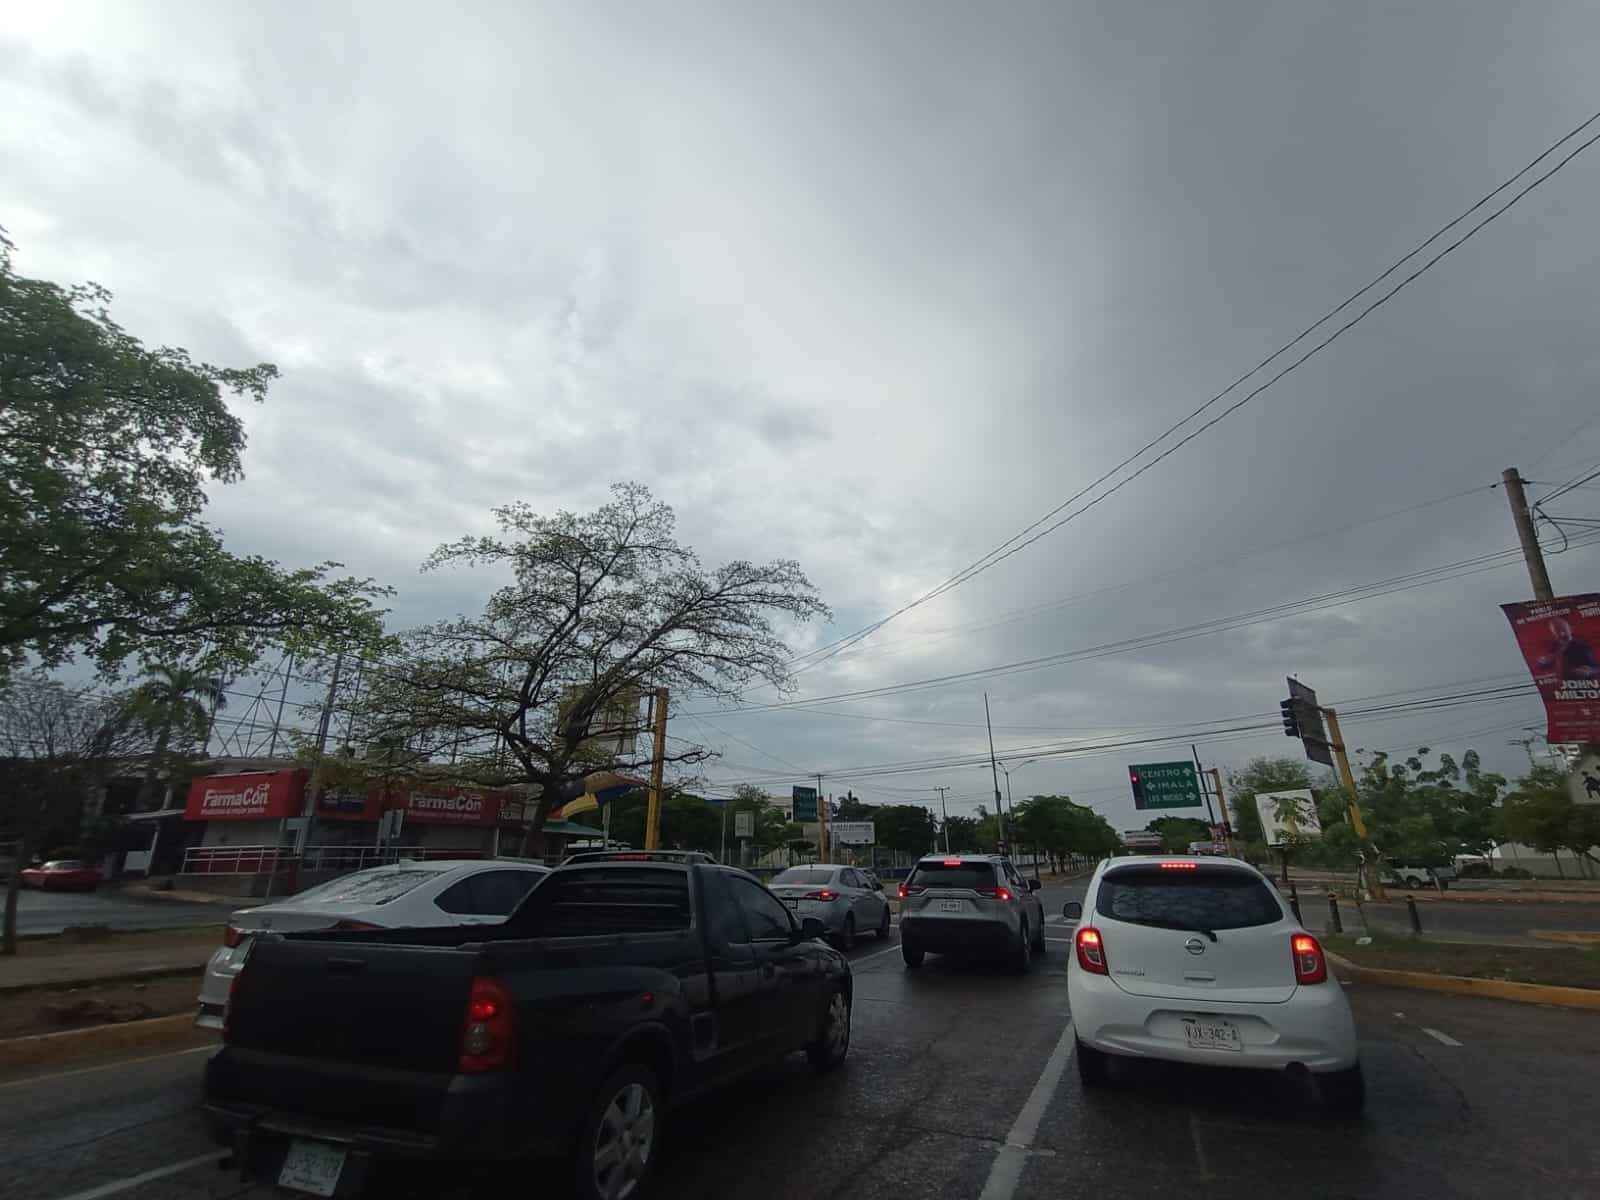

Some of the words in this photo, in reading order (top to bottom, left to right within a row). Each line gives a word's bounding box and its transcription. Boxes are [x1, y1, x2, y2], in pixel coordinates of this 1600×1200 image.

[1560, 680, 1600, 690] JOHN
[1554, 689, 1600, 700] MILTO
[1142, 768, 1180, 778] CENTRO
[1157, 780, 1193, 790] IMALA
